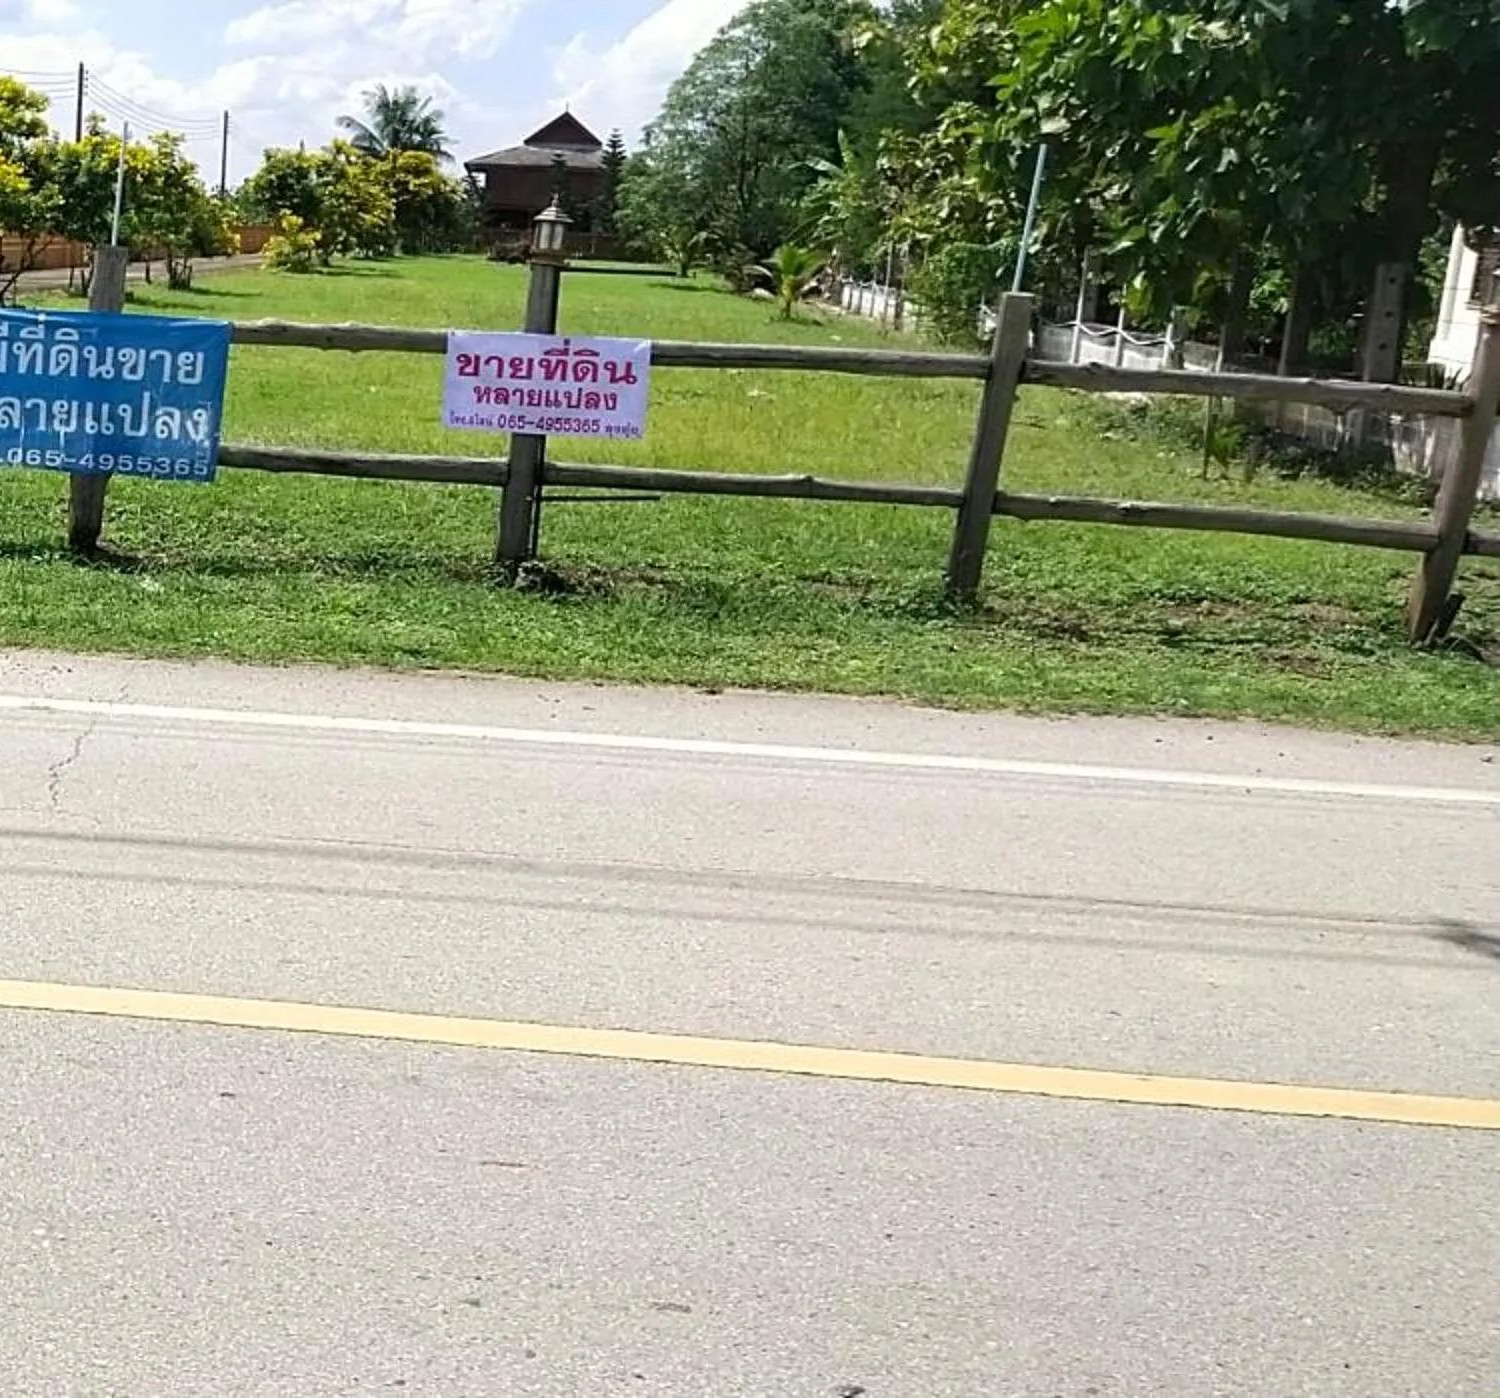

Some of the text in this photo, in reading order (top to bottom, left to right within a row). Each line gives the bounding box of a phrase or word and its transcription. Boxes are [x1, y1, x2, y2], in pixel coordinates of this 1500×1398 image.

[456, 338, 637, 384] ขายที่ดิน
[474, 385, 618, 411] หลายแปลง
[497, 414, 600, 433] 065-4955365
